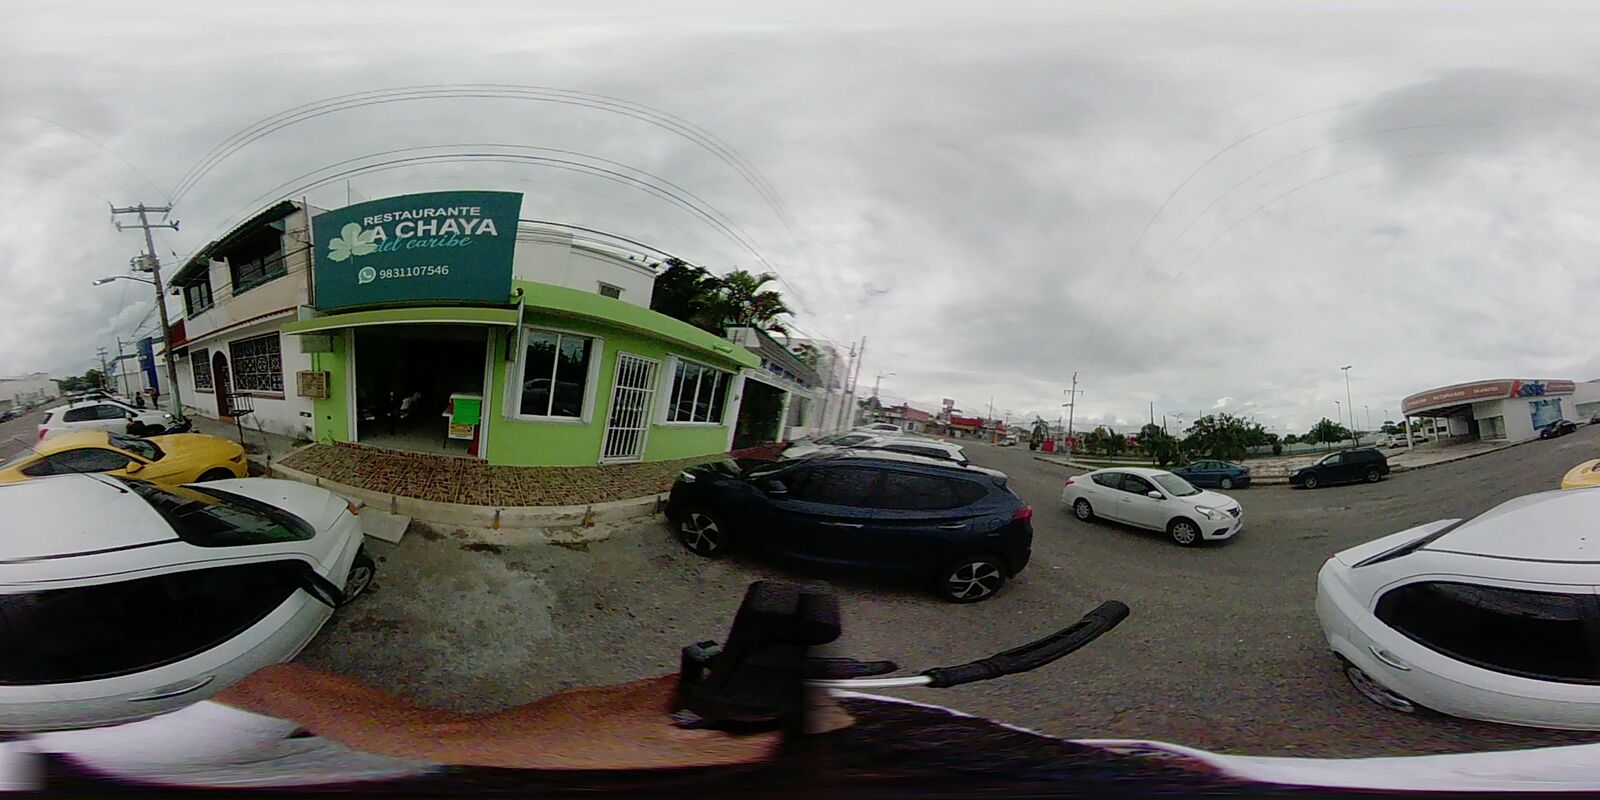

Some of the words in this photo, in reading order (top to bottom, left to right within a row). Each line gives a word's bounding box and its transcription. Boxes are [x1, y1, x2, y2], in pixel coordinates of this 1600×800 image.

[364, 206, 481, 225] RESTAURANTE
[395, 218, 498, 238] CHAYA
[406, 234, 472, 248] caribe
[379, 265, 449, 279] 9831107546
